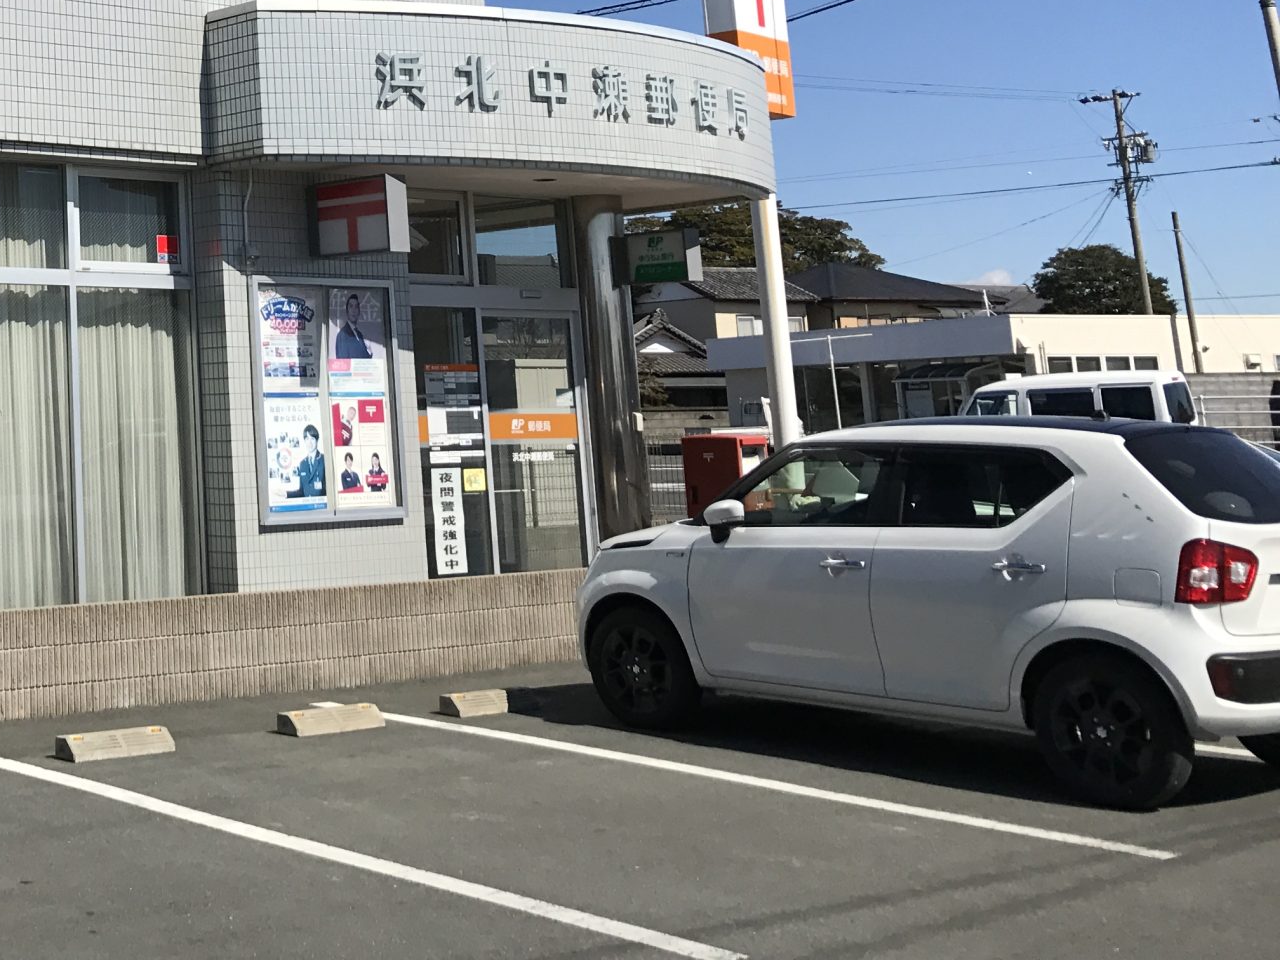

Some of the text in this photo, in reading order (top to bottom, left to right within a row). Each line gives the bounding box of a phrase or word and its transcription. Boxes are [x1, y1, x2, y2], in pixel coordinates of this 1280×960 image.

[375, 51, 750, 140] 浜北中瀬郵便局
[527, 420, 552, 432] 郵便局
[439, 472, 459, 570] 夜間警戒強化中
